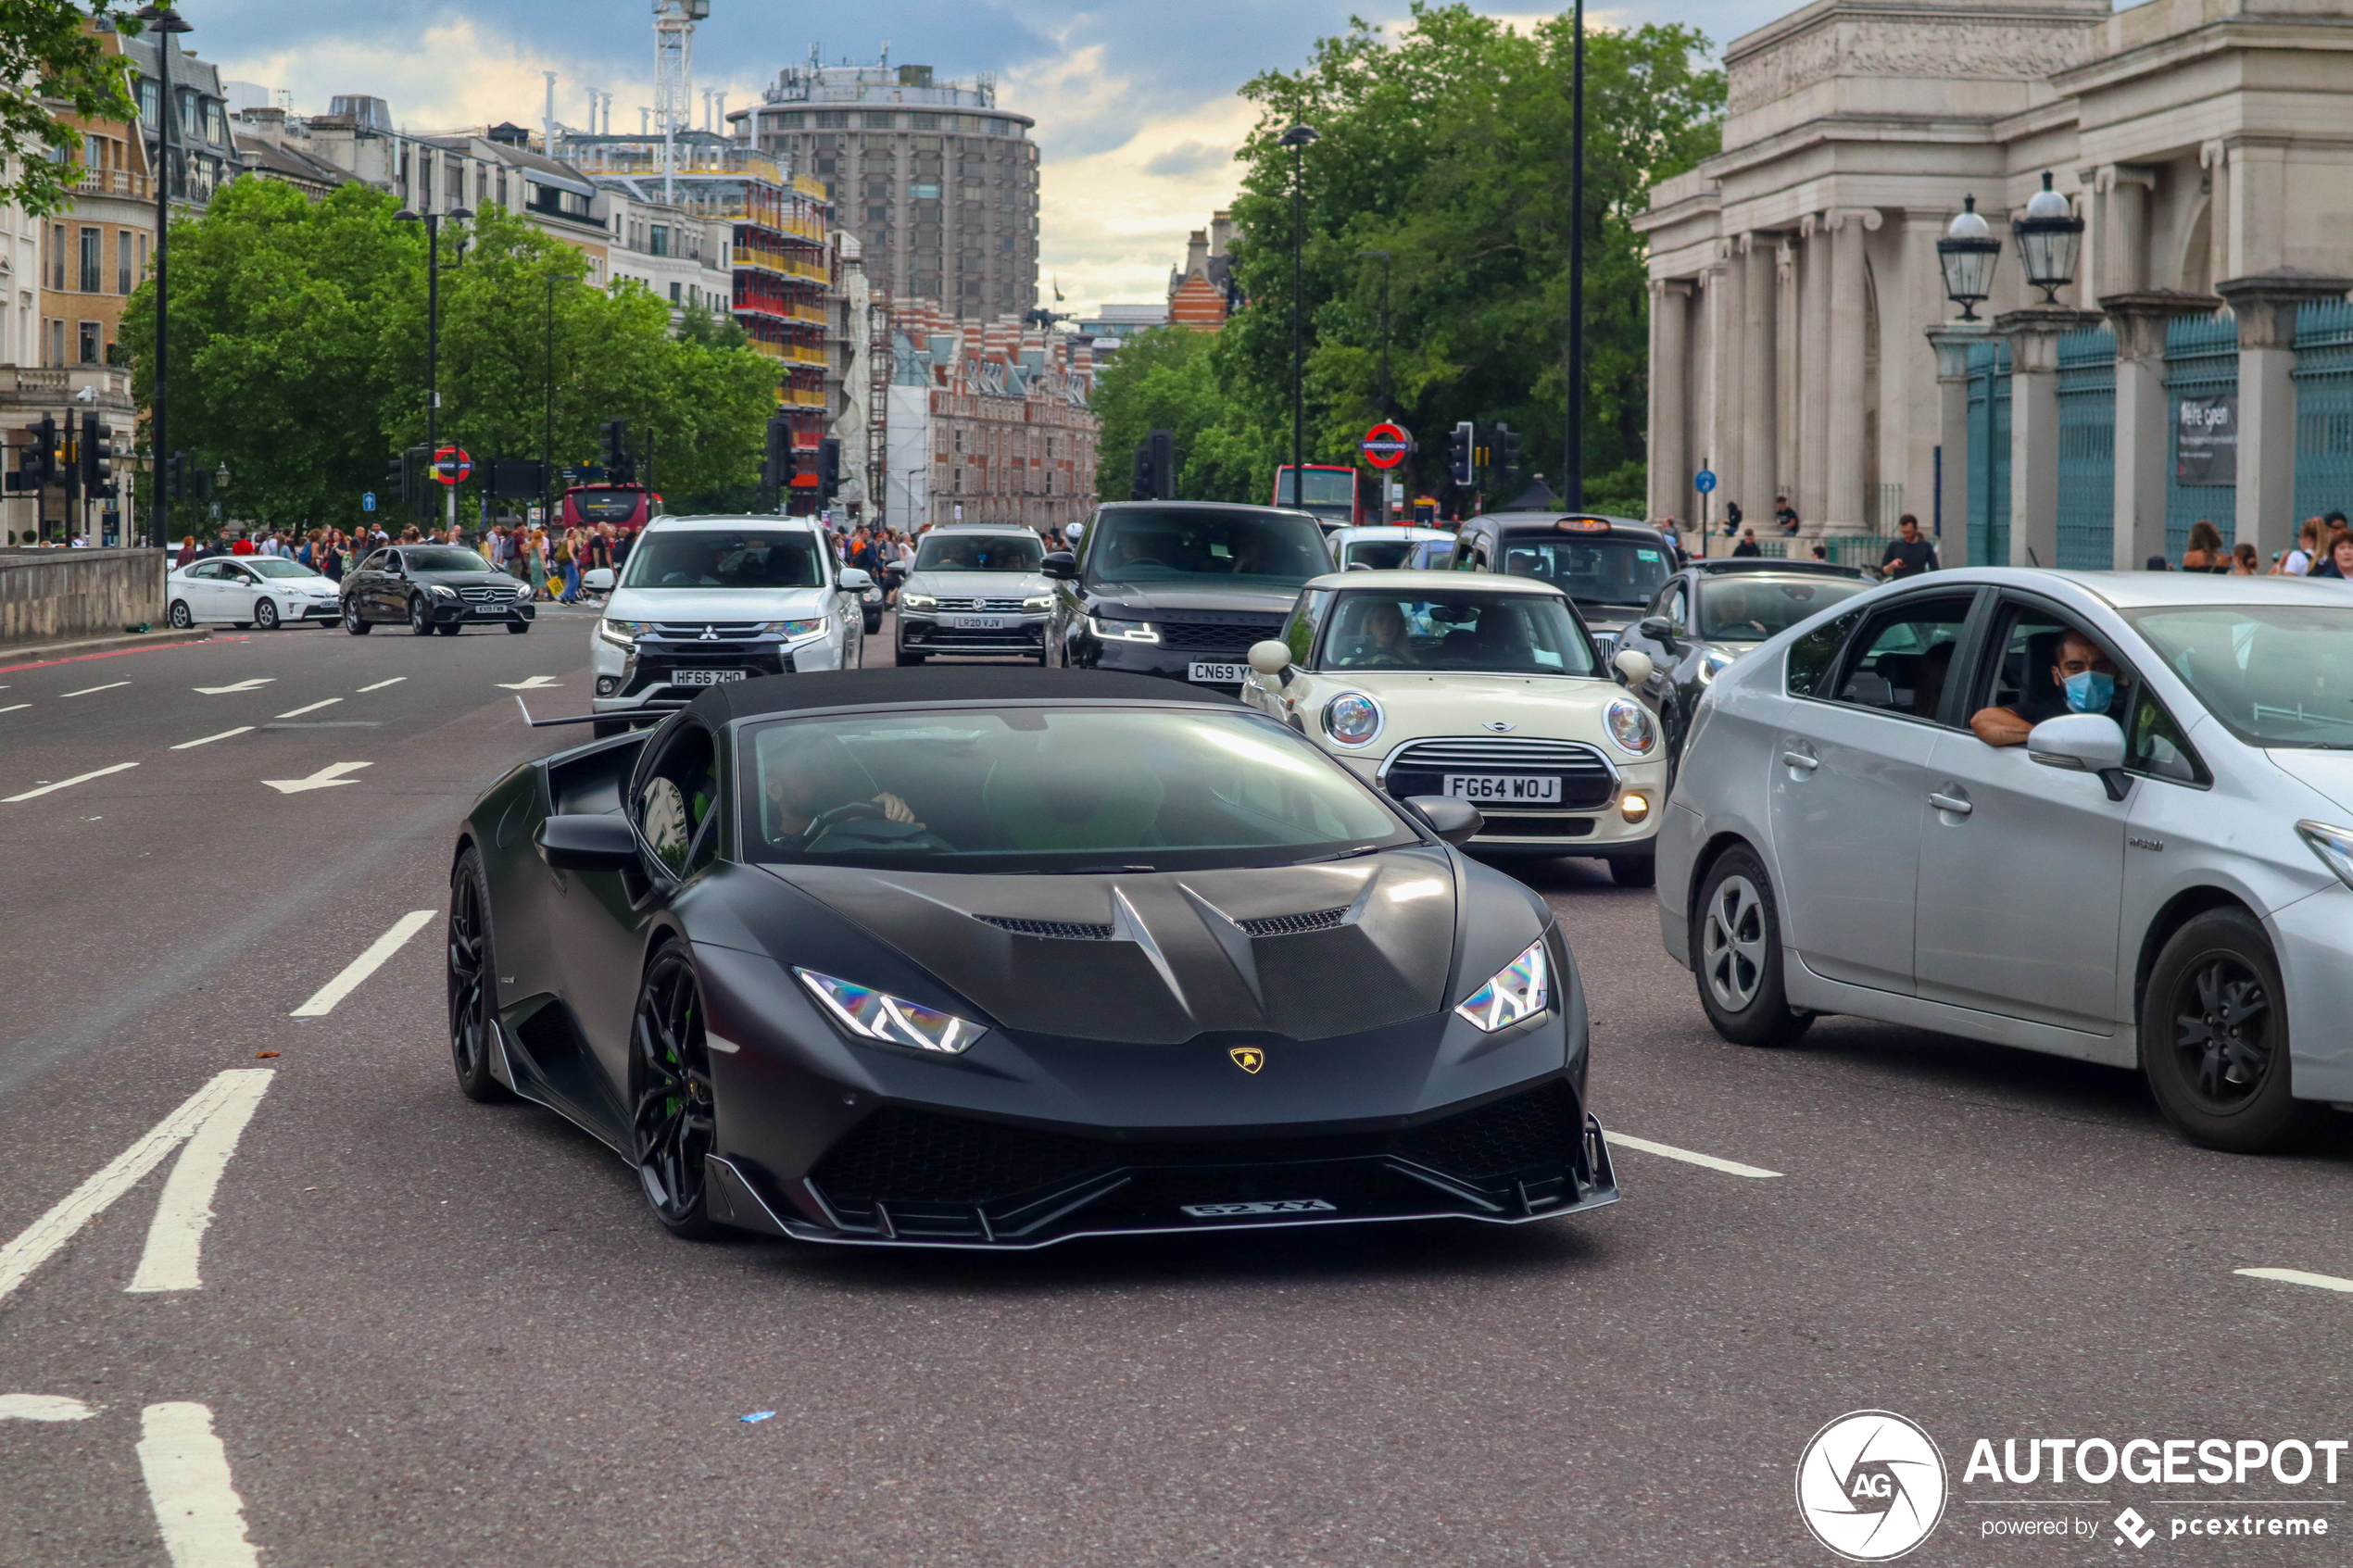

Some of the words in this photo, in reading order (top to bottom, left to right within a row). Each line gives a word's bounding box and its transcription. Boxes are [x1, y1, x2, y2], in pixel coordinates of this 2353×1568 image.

[958, 619, 981, 627] LR20
[983, 619, 1000, 627] VJV
[677, 671, 711, 684] HF66
[1195, 664, 1234, 679] CN69
[1453, 778, 1506, 797] FG64
[1514, 779, 1553, 797] WOJ
